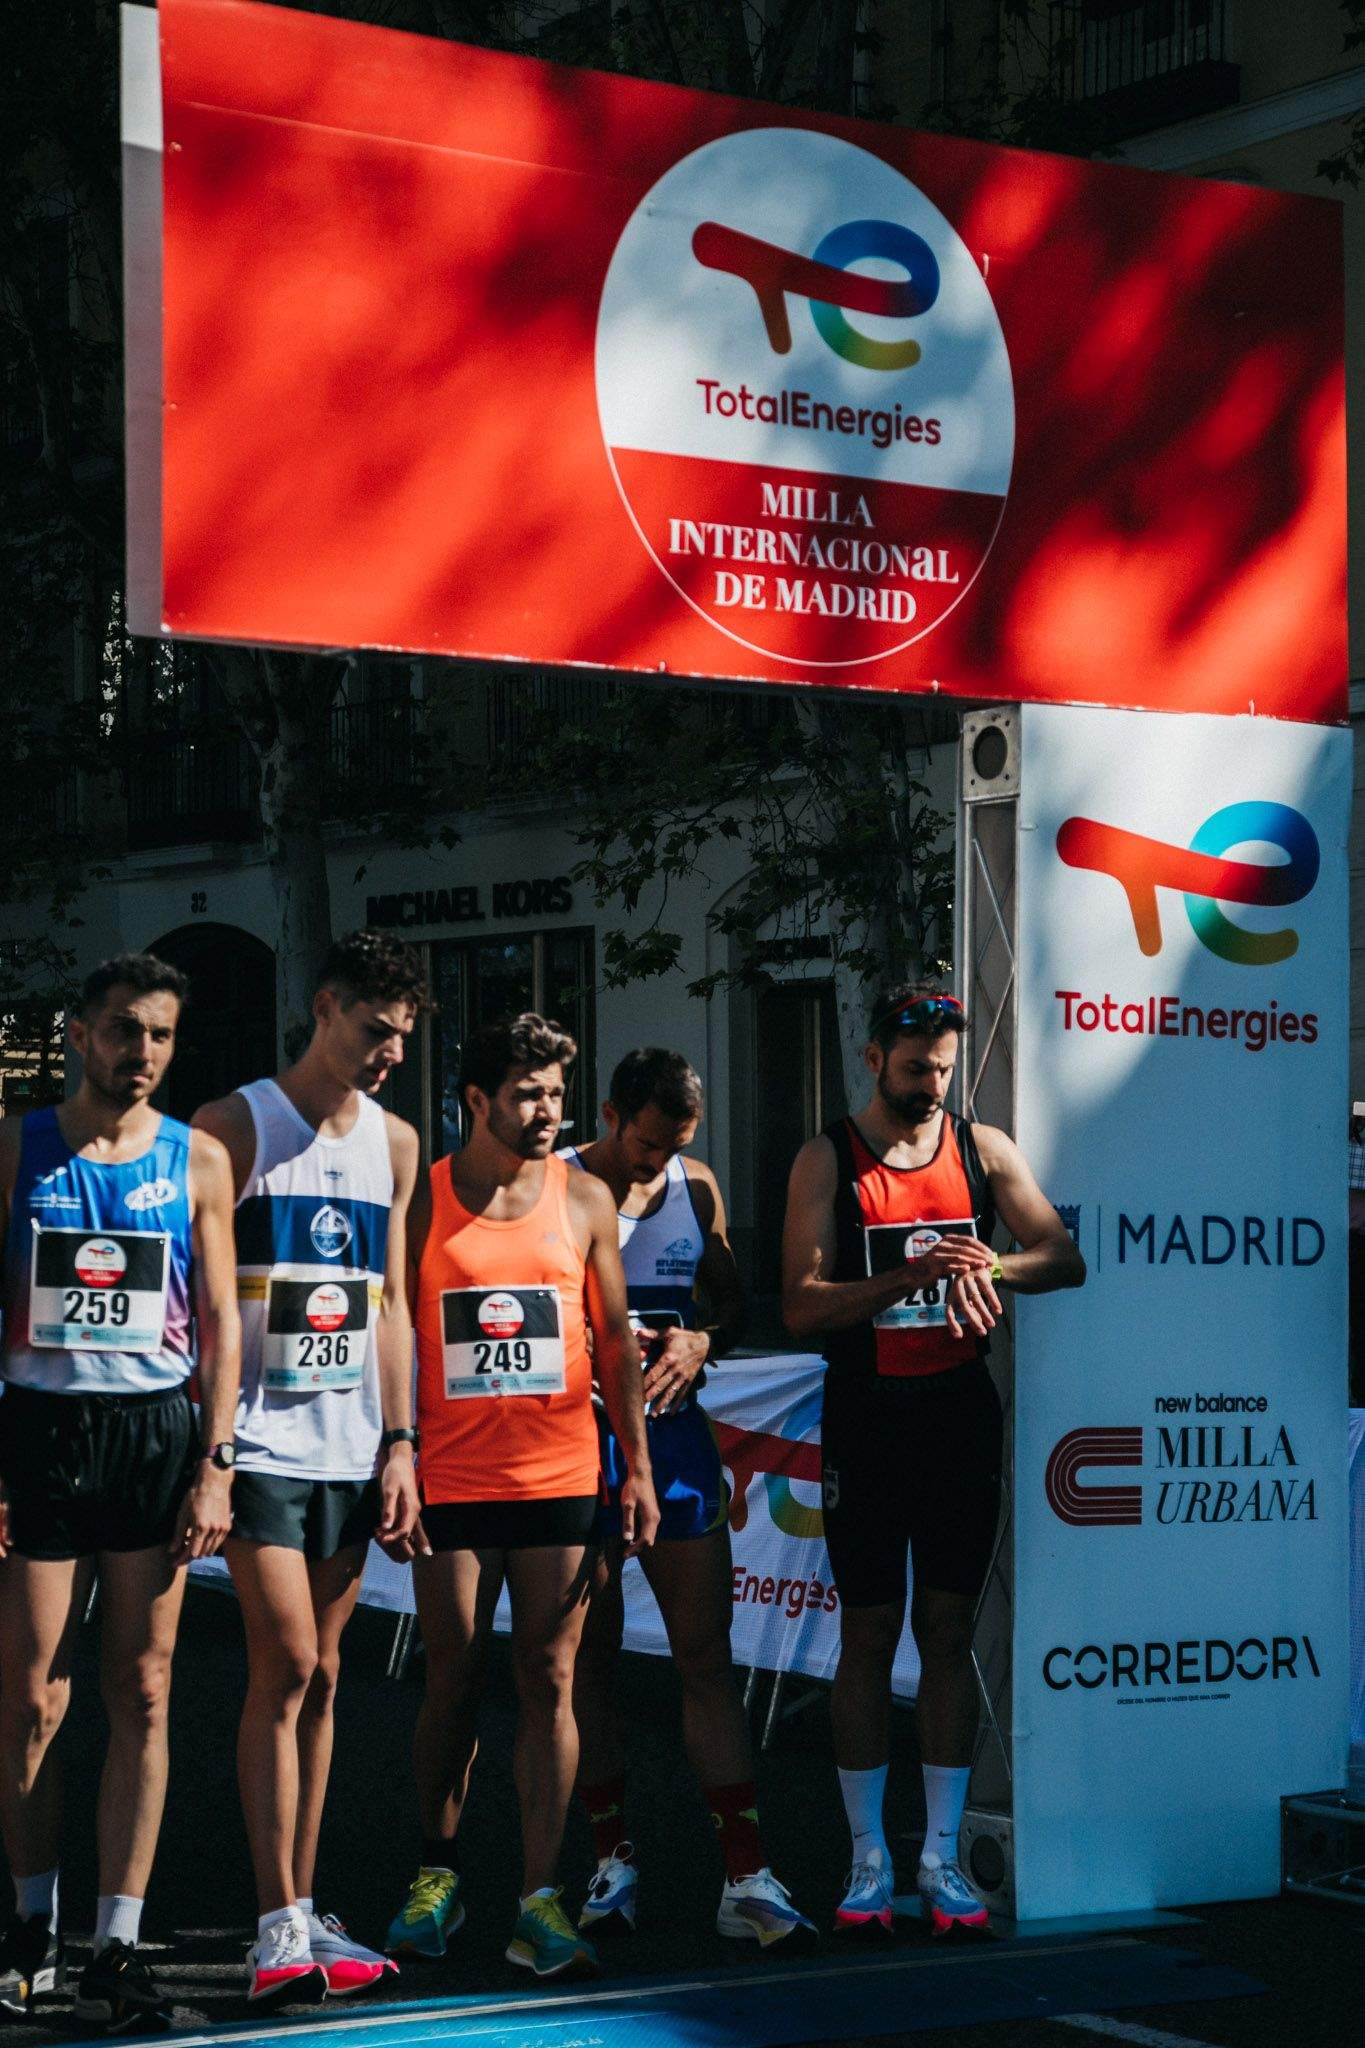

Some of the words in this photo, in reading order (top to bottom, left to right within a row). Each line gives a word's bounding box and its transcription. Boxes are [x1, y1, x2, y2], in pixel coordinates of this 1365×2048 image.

[696, 379, 942, 448] TotalEnergies
[760, 482, 875, 528] MILLA
[714, 571, 765, 610] DE
[774, 577, 917, 624] MADRID
[366, 886, 486, 927] MICHAEL
[492, 876, 573, 919] KORS
[1055, 990, 1318, 1052] TotalEnergies
[1118, 1213, 1325, 1267] MADRID
[63, 1290, 131, 1326] 259
[298, 1334, 349, 1368] 236
[473, 1340, 532, 1375] 249
[1155, 1396, 1190, 1413] new
[1195, 1392, 1268, 1413] balance
[1155, 1424, 1300, 1469] MILLA
[1156, 1478, 1319, 1525] URBANA
